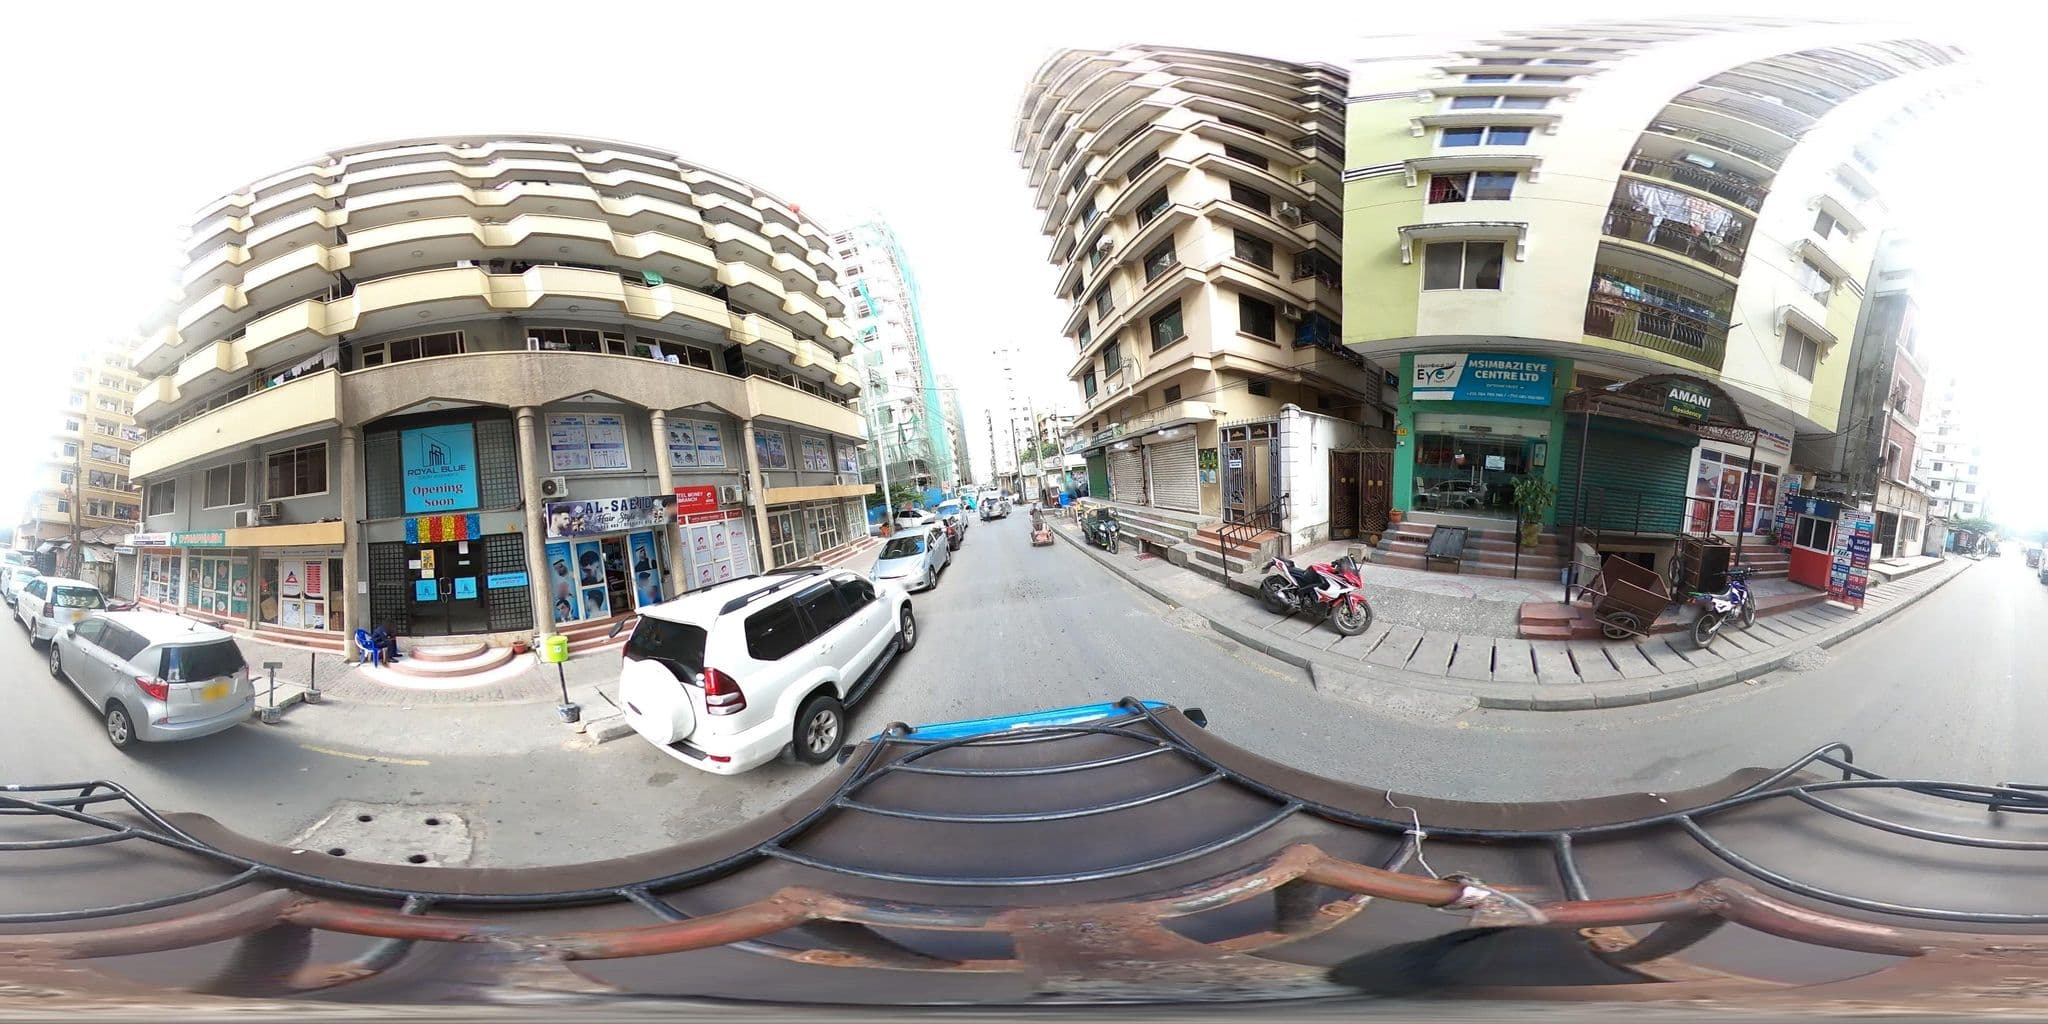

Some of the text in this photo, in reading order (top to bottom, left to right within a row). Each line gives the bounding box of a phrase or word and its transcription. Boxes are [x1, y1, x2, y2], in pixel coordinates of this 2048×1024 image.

[1468, 360, 1548, 372] MSIMBAZI EYE
[1475, 370, 1540, 382] CENTRE LTD
[1668, 387, 1711, 409] AMANI
[1672, 405, 1702, 419] Residency
[407, 467, 439, 477] ROYAL
[440, 464, 468, 474] BLUE
[412, 483, 464, 497] Opening
[585, 496, 652, 514] AL-SAEID
[597, 512, 616, 524] Hair
